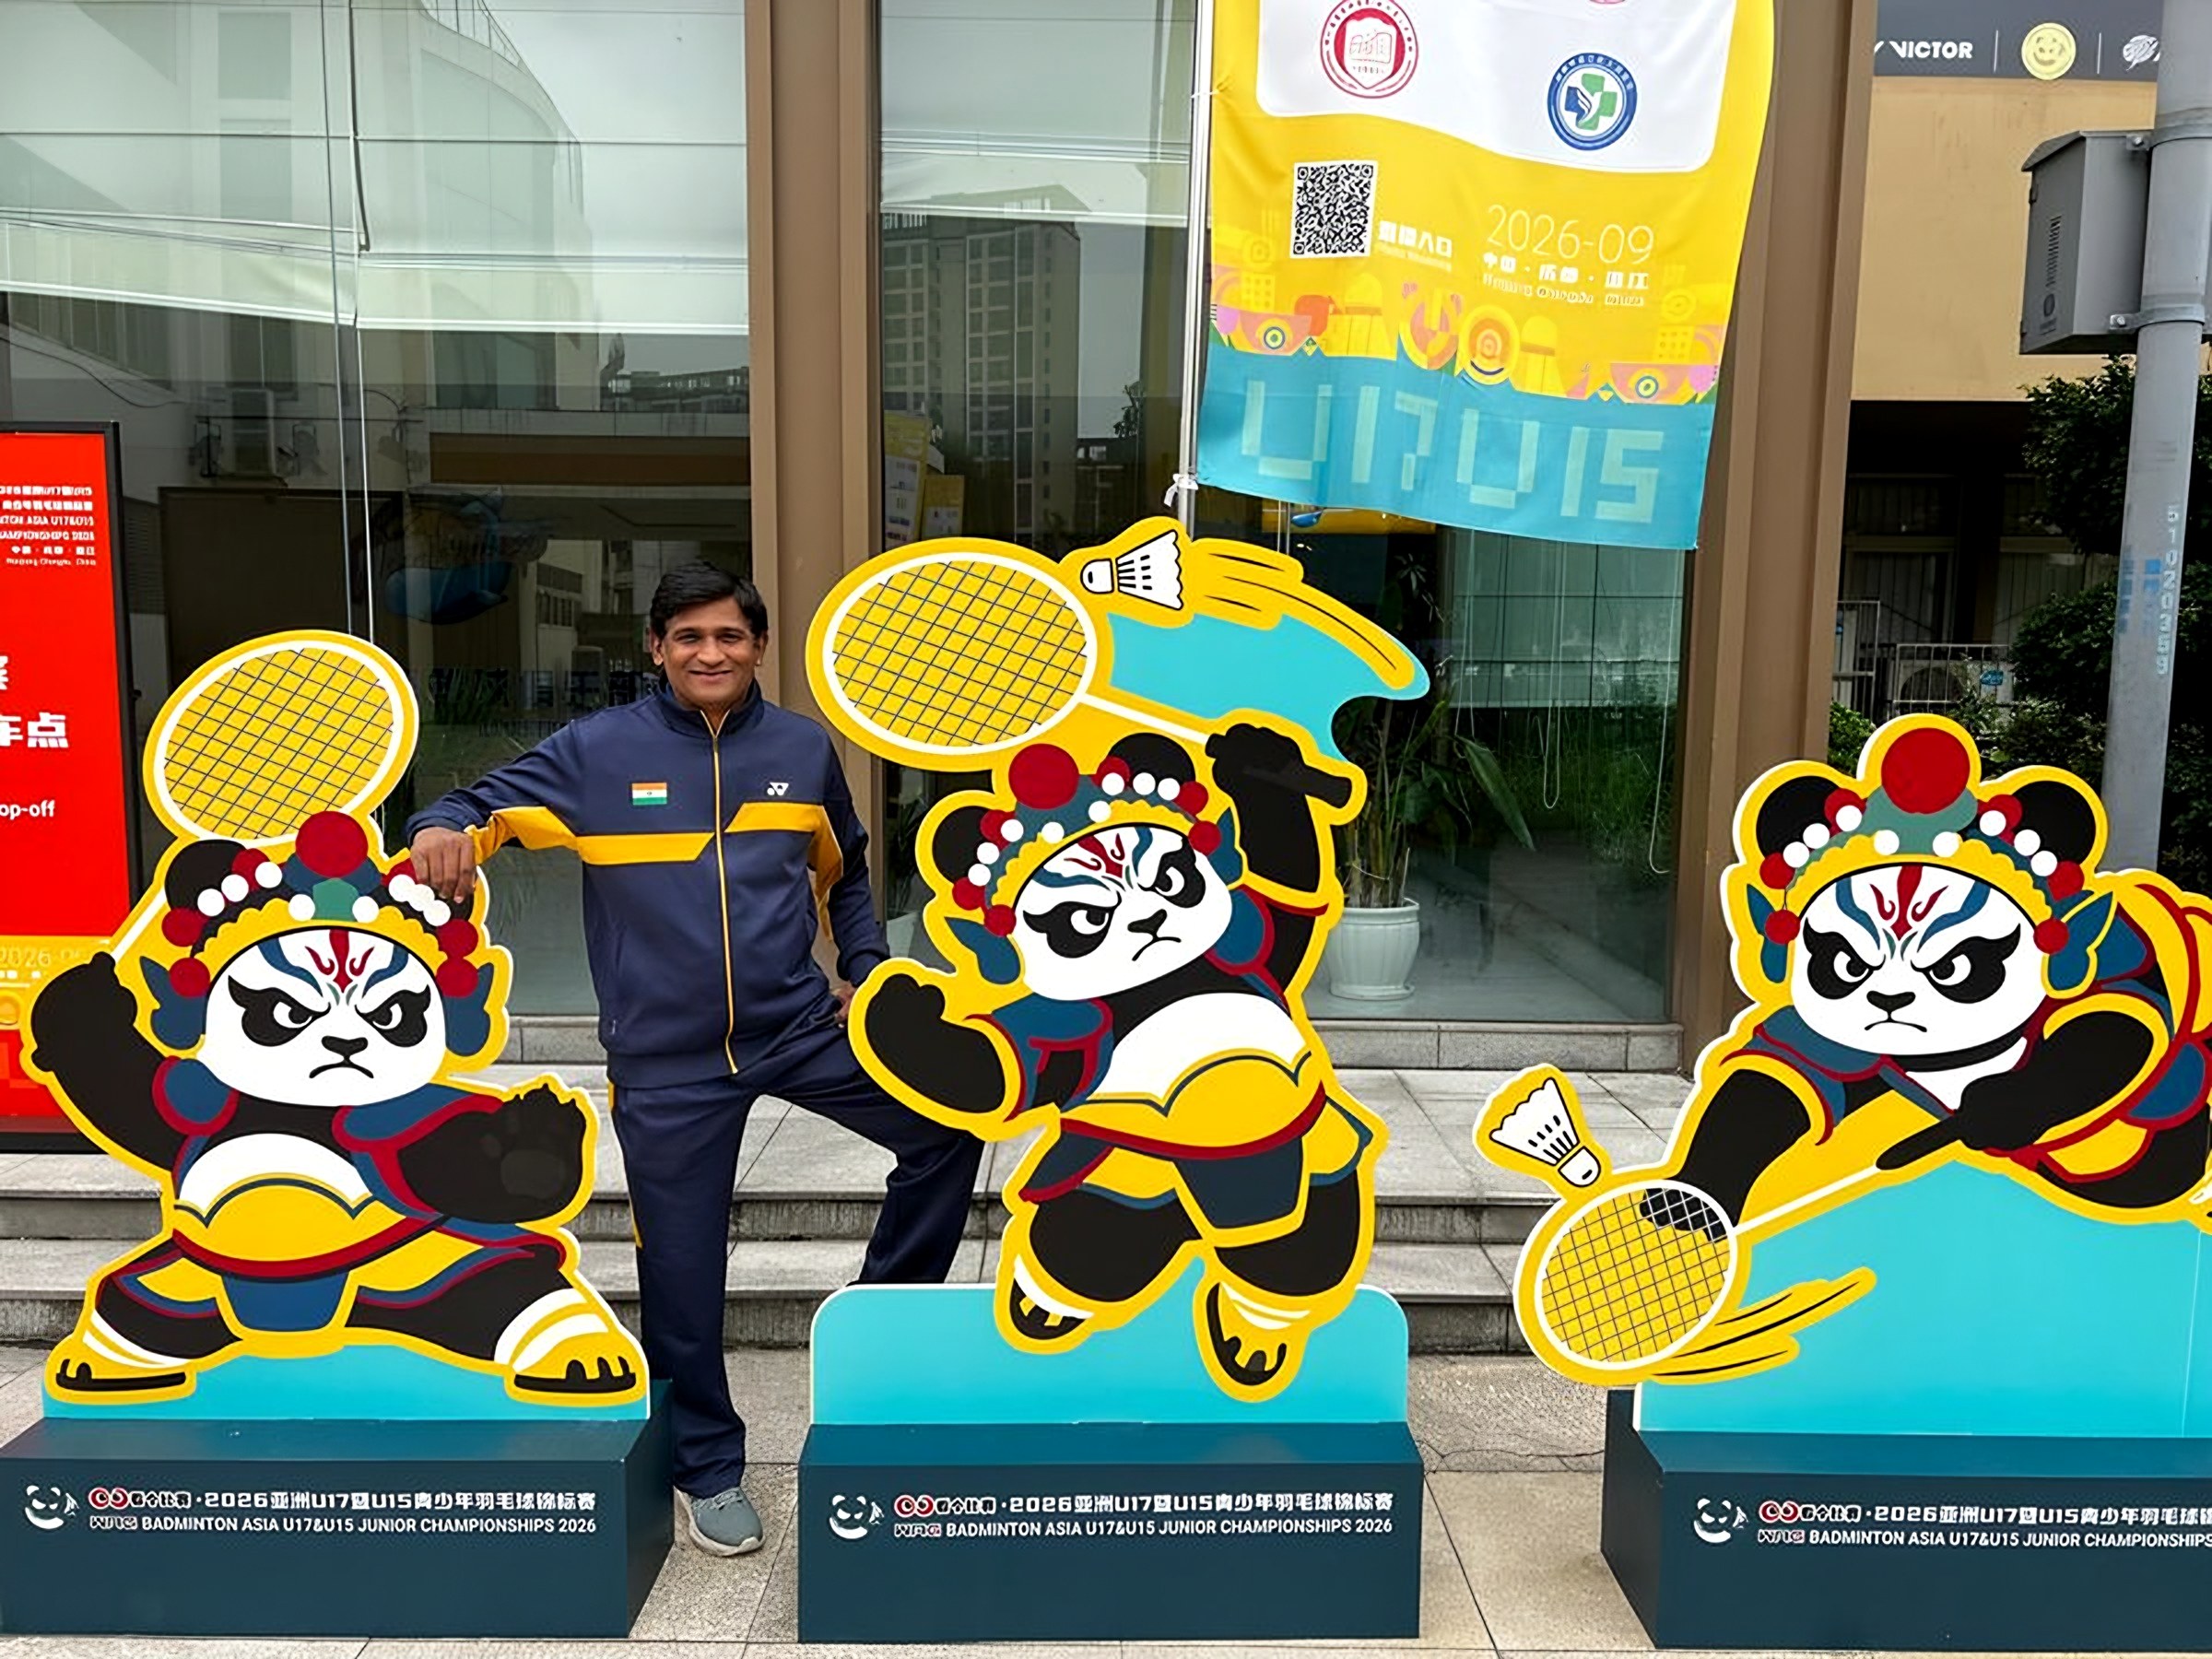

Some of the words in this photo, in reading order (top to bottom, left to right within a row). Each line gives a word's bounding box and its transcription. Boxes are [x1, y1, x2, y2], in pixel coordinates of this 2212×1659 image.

[1888, 41, 1973, 59] VICTOR
[1487, 205, 1654, 265] 2026-09
[141, 1516, 238, 1531] BADMINTON
[241, 1517, 279, 1532] ASIA
[283, 1517, 354, 1533] U17&U15
[358, 1517, 417, 1533] JUNIOR
[420, 1517, 555, 1533] CHAMPIONSHIPS
[559, 1518, 596, 1533] 2026
[946, 1521, 1041, 1537] BADMINTON
[1044, 1521, 1083, 1536] ASIA
[1086, 1520, 1156, 1535] U17&U15
[1158, 1519, 1217, 1535] JUNIOR
[1220, 1518, 1352, 1535] CHAMPIONSHIPS
[1355, 1518, 1393, 1533] 2026
[1808, 1529, 1905, 1545] BADMINTON
[1907, 1531, 1946, 1546] ASIA
[1948, 1531, 2019, 1547] U17&U15
[2022, 1532, 2081, 1547] JUNIOR
